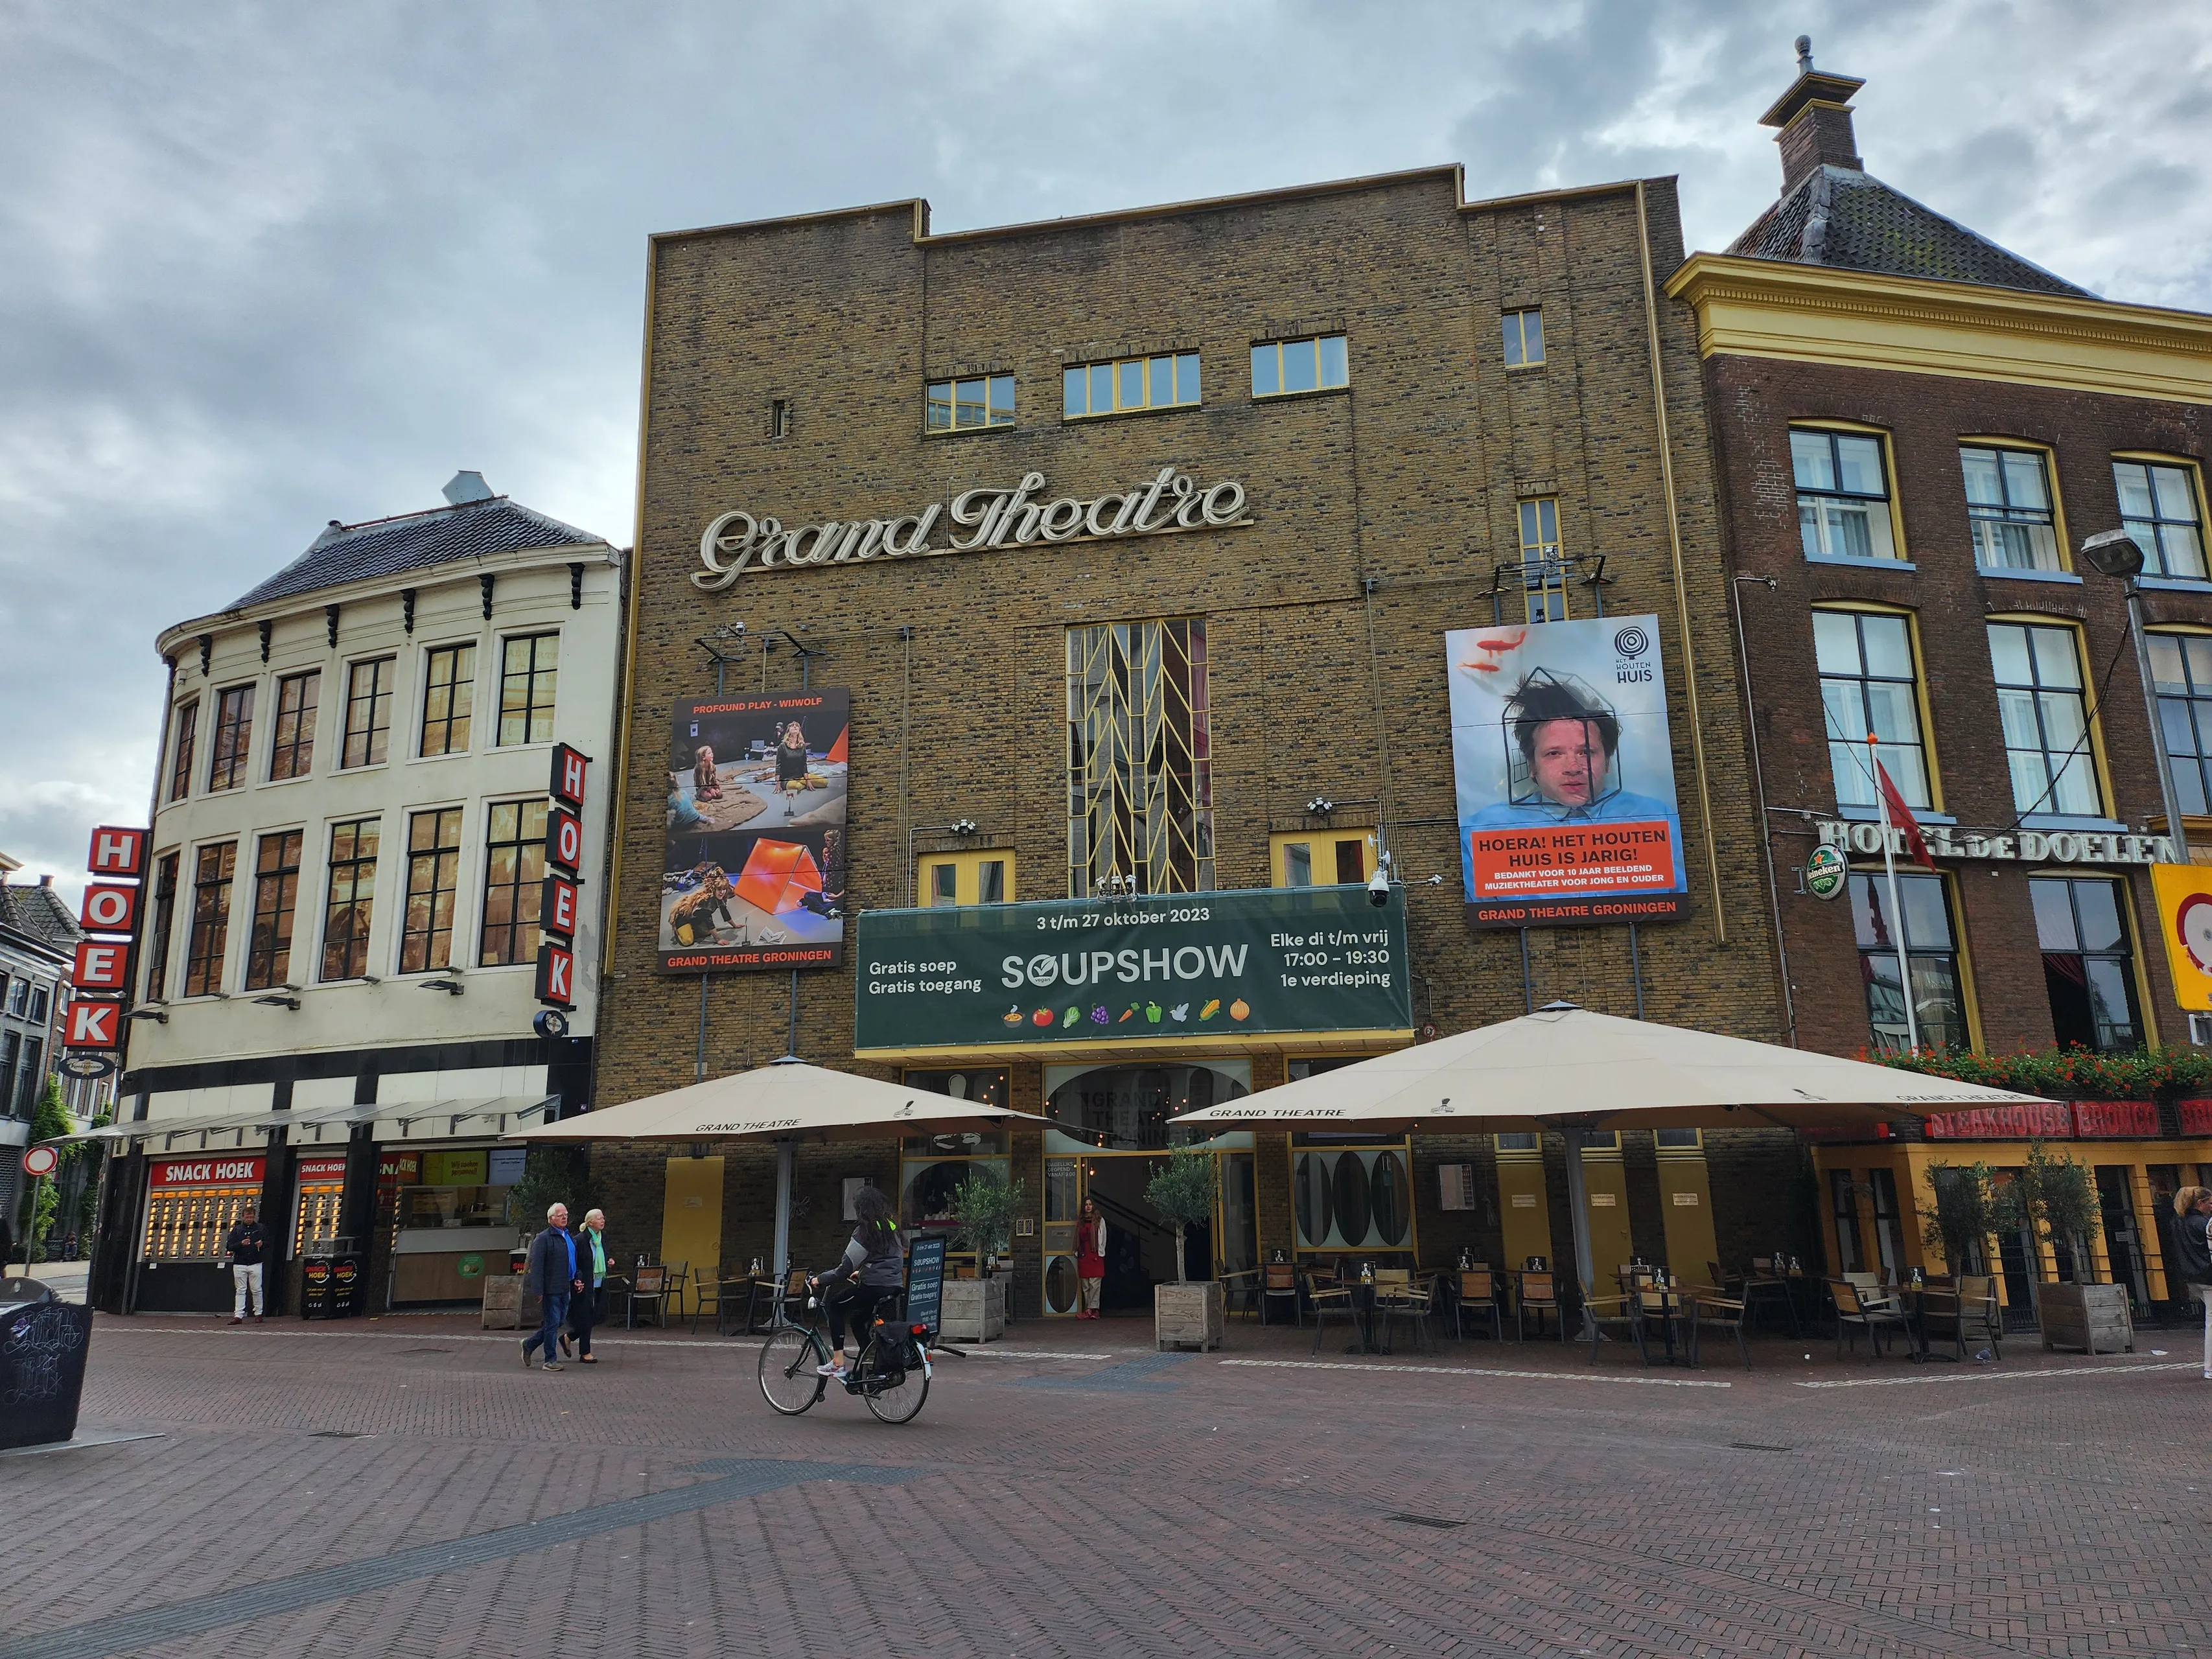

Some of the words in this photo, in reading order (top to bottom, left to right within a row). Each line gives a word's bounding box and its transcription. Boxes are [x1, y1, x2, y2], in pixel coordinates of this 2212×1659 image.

[690, 503, 943, 592] Grand
[949, 467, 1251, 551] Theatre
[1616, 662, 1651, 670] HOUTEN
[1617, 669, 1653, 684] HUIS
[693, 702, 745, 713] PROFOUND
[748, 701, 772, 710] PLAY
[779, 697, 822, 708] WIJWOLF
[1479, 837, 1545, 852] HOERA!
[1553, 834, 1585, 848] HET
[1592, 830, 1666, 846] HOUTEN
[1966, 835, 2015, 859] DE
[2017, 830, 2176, 864] DOELEN
[1509, 852, 1552, 867] HUIS
[1558, 852, 1576, 864] IS
[1581, 848, 1638, 863] JARIG!
[551, 754, 581, 997] HOEK
[1495, 870, 1536, 879] BEDANKT
[1539, 869, 1564, 877] VOOR
[1567, 868, 1576, 876] 10
[1579, 866, 1601, 875] JAAR
[1604, 864, 1652, 874] BEELDEND
[1809, 864, 1841, 879] eineken
[1485, 879, 1559, 890] MUZIEKTHEATER
[1561, 877, 1587, 887] VOOR
[1589, 876, 1614, 885] JONG
[1616, 875, 1629, 883] EN
[1631, 874, 1664, 883] OUDER
[1036, 916, 1046, 930] 3
[1050, 914, 1078, 931] t/m
[1082, 914, 1100, 927] 27
[1104, 911, 1167, 927] oktober
[1170, 907, 1210, 923] 2023
[1478, 909, 1526, 921] GRAND
[1529, 905, 1589, 918] THEATRE
[1592, 901, 1676, 915] GRONINGEN
[73, 833, 134, 1041] HOEK
[1270, 933, 1304, 947] Elke
[1309, 932, 1324, 946] di
[1328, 930, 1358, 947] t/m
[1362, 929, 1389, 947] vrij
[668, 956, 708, 968] GRAND
[710, 953, 760, 965] THEATRE
[762, 949, 832, 963] GRONINGEN
[1001, 944, 1249, 989] SOUPSHOW
[1283, 952, 1328, 967] 17:00
[1345, 949, 1390, 965] 19:30
[869, 960, 915, 975] Gratis
[919, 960, 957, 974] soep
[868, 979, 915, 995] Gratis
[919, 979, 982, 994] toegang
[1280, 973, 1298, 988] 1e
[1301, 970, 1391, 988] verdieping
[695, 1123, 740, 1132] GRAND
[742, 1118, 802, 1130] THEATRE
[1930, 1103, 2070, 1136] STEAKHOUSE
[2078, 1104, 2158, 1135] BRONCO
[165, 1164, 211, 1182] SNACK
[215, 1161, 255, 1179] HOEK
[301, 1164, 326, 1174] SNACK
[914, 1257, 940, 1266] SOUPSHOW
[911, 1282, 927, 1292] Gratis
[927, 1281, 938, 1290] soep
